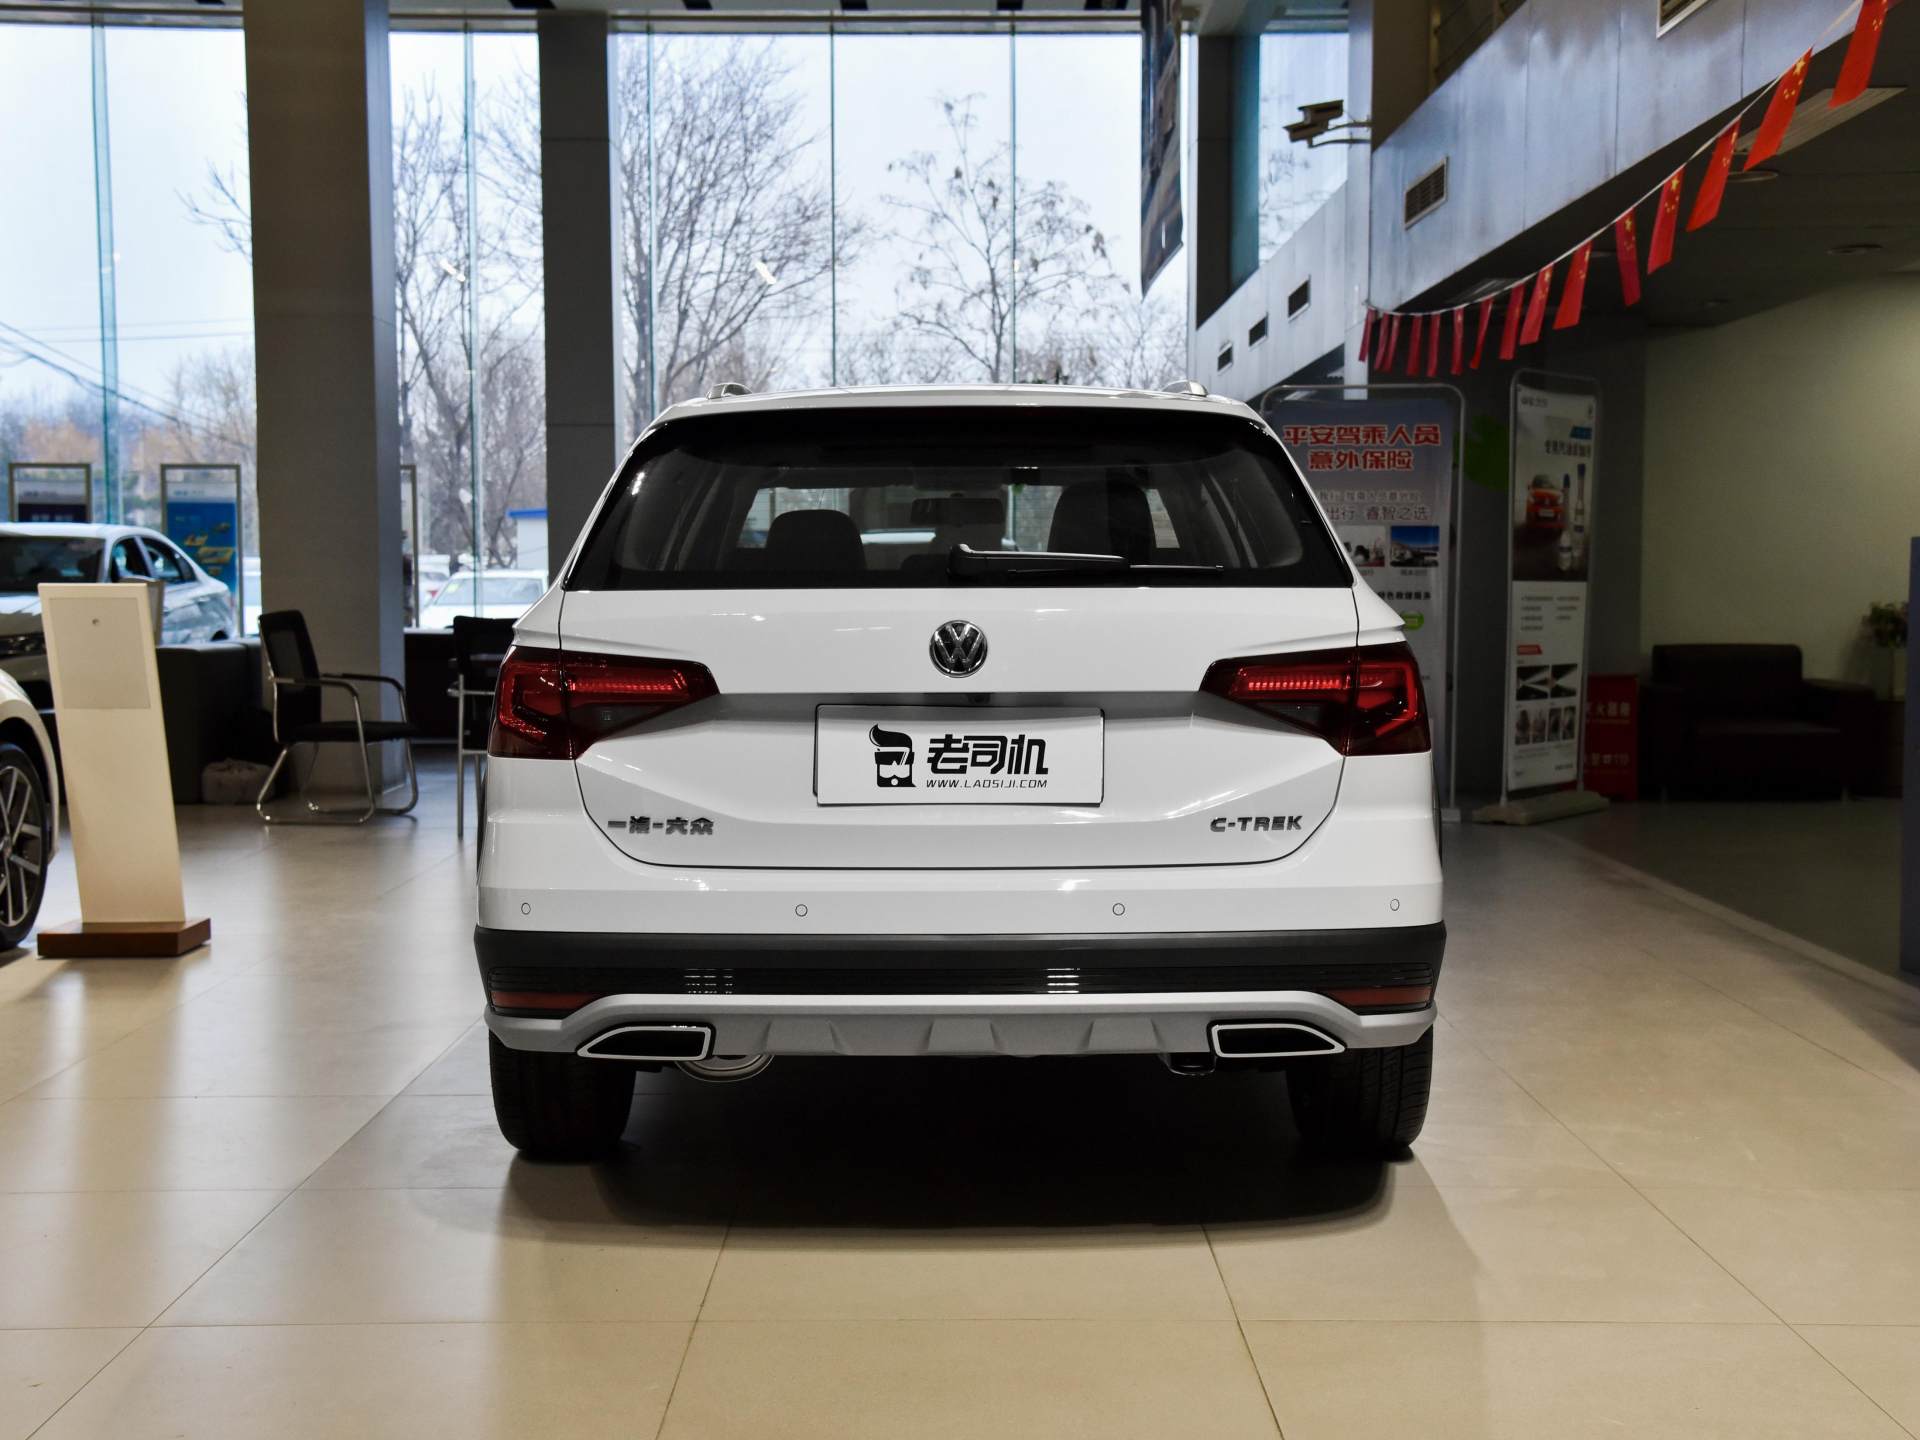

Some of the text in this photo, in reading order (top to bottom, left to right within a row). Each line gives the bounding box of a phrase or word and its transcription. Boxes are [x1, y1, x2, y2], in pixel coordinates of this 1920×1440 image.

[1284, 424, 1441, 446] 平安驾乘人员
[1309, 450, 1413, 471] 意外保险
[927, 734, 1048, 775] 老司机
[926, 779, 1048, 788] WWW.LAOSIJI.COM
[1210, 816, 1303, 832] C-TREK
